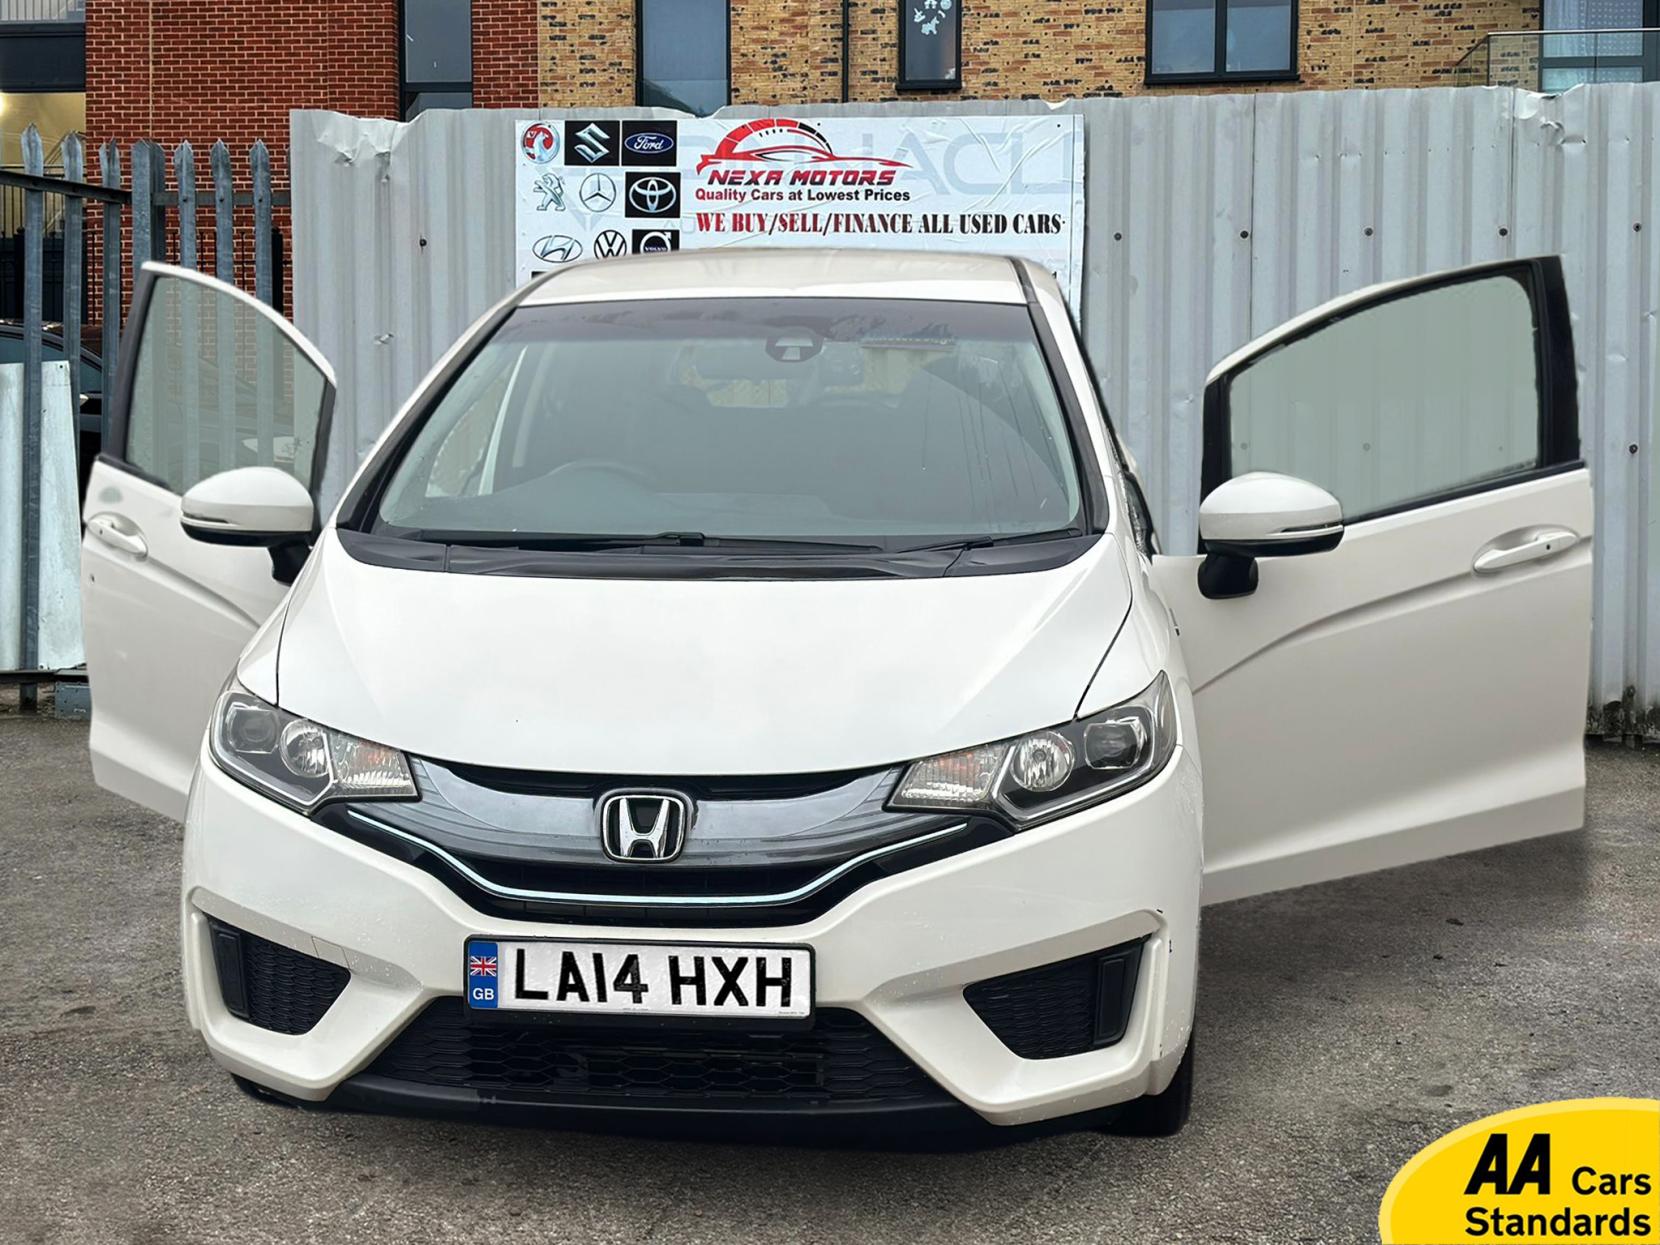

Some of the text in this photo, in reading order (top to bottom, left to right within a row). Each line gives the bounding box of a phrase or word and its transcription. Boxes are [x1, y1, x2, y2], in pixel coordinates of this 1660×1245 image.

[634, 137, 664, 151] Ford
[707, 170, 896, 186] NEXA MOTORS
[695, 188, 910, 203] Quality Cars at Lowest Prices
[696, 212, 725, 233] WE
[918, 213, 953, 234] ALL
[959, 213, 1007, 234] USED
[514, 948, 792, 1007] LA14 HXH
[472, 987, 495, 1001] GB
